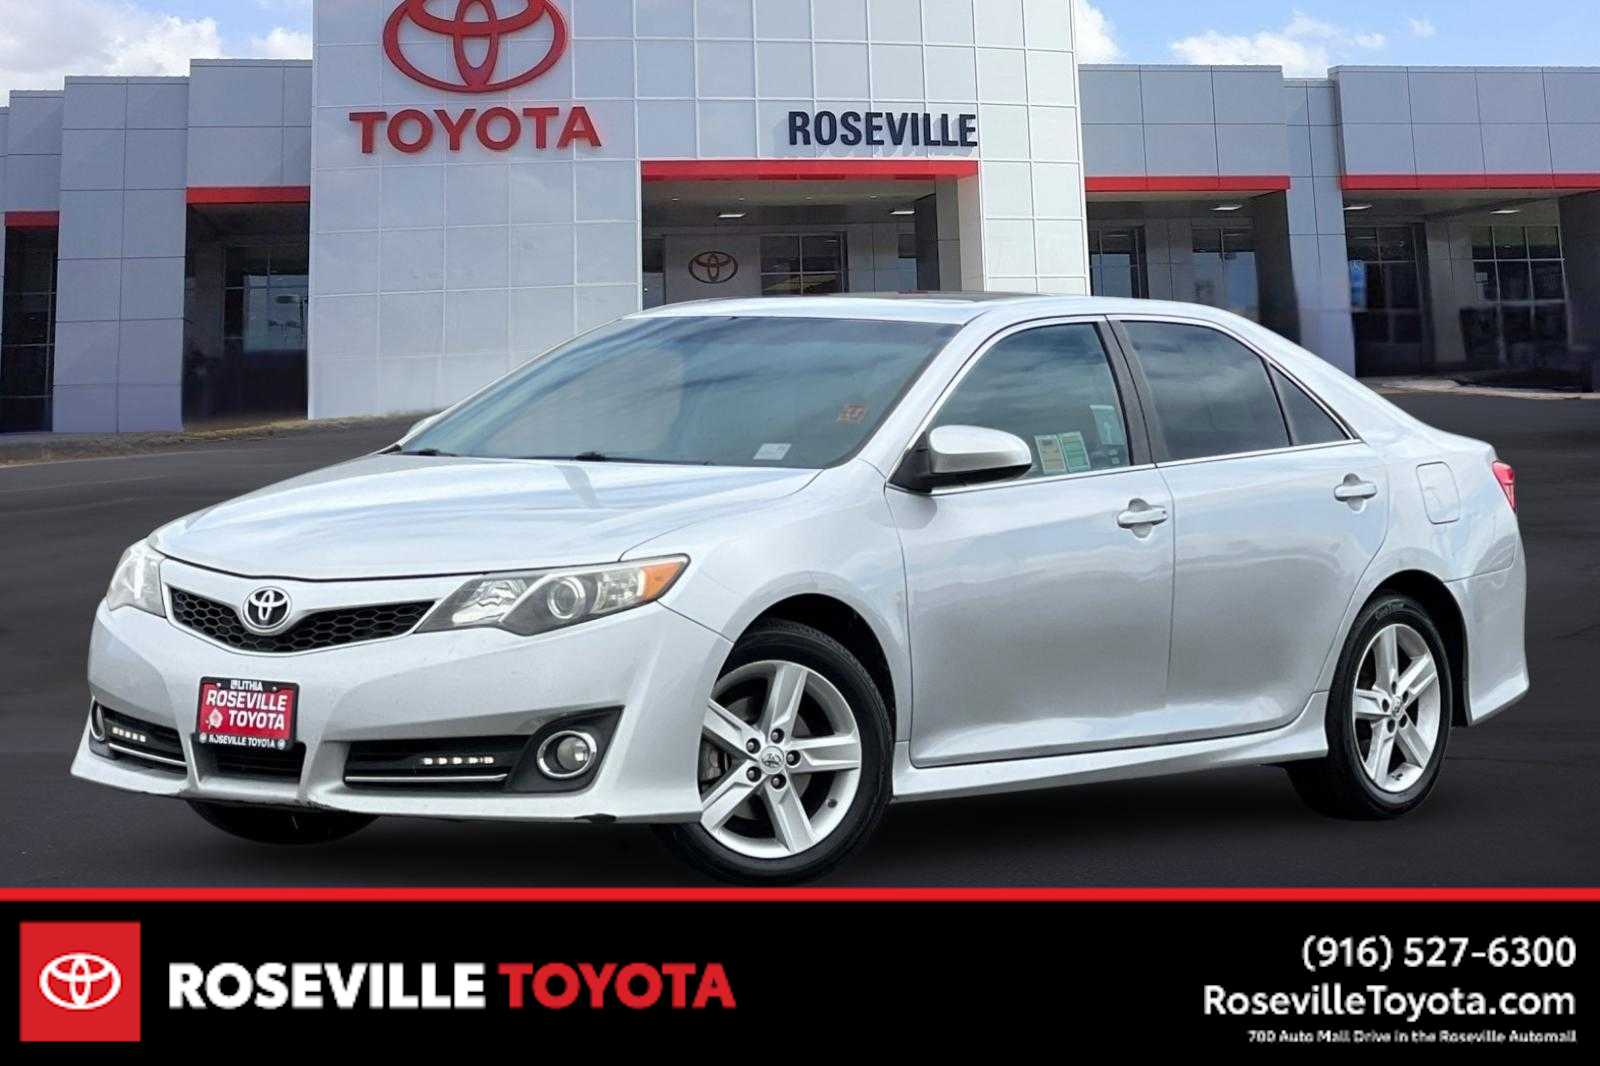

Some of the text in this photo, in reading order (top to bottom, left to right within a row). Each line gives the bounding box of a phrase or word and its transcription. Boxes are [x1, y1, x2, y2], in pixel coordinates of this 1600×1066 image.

[349, 105, 602, 154] TOYOTA
[789, 111, 978, 147] ROSEVILLE
[239, 680, 263, 691] LITHIA
[205, 689, 287, 711] ROSEVILLE
[228, 710, 285, 730] TOYOTA
[247, 737, 276, 748] TOYOTA
